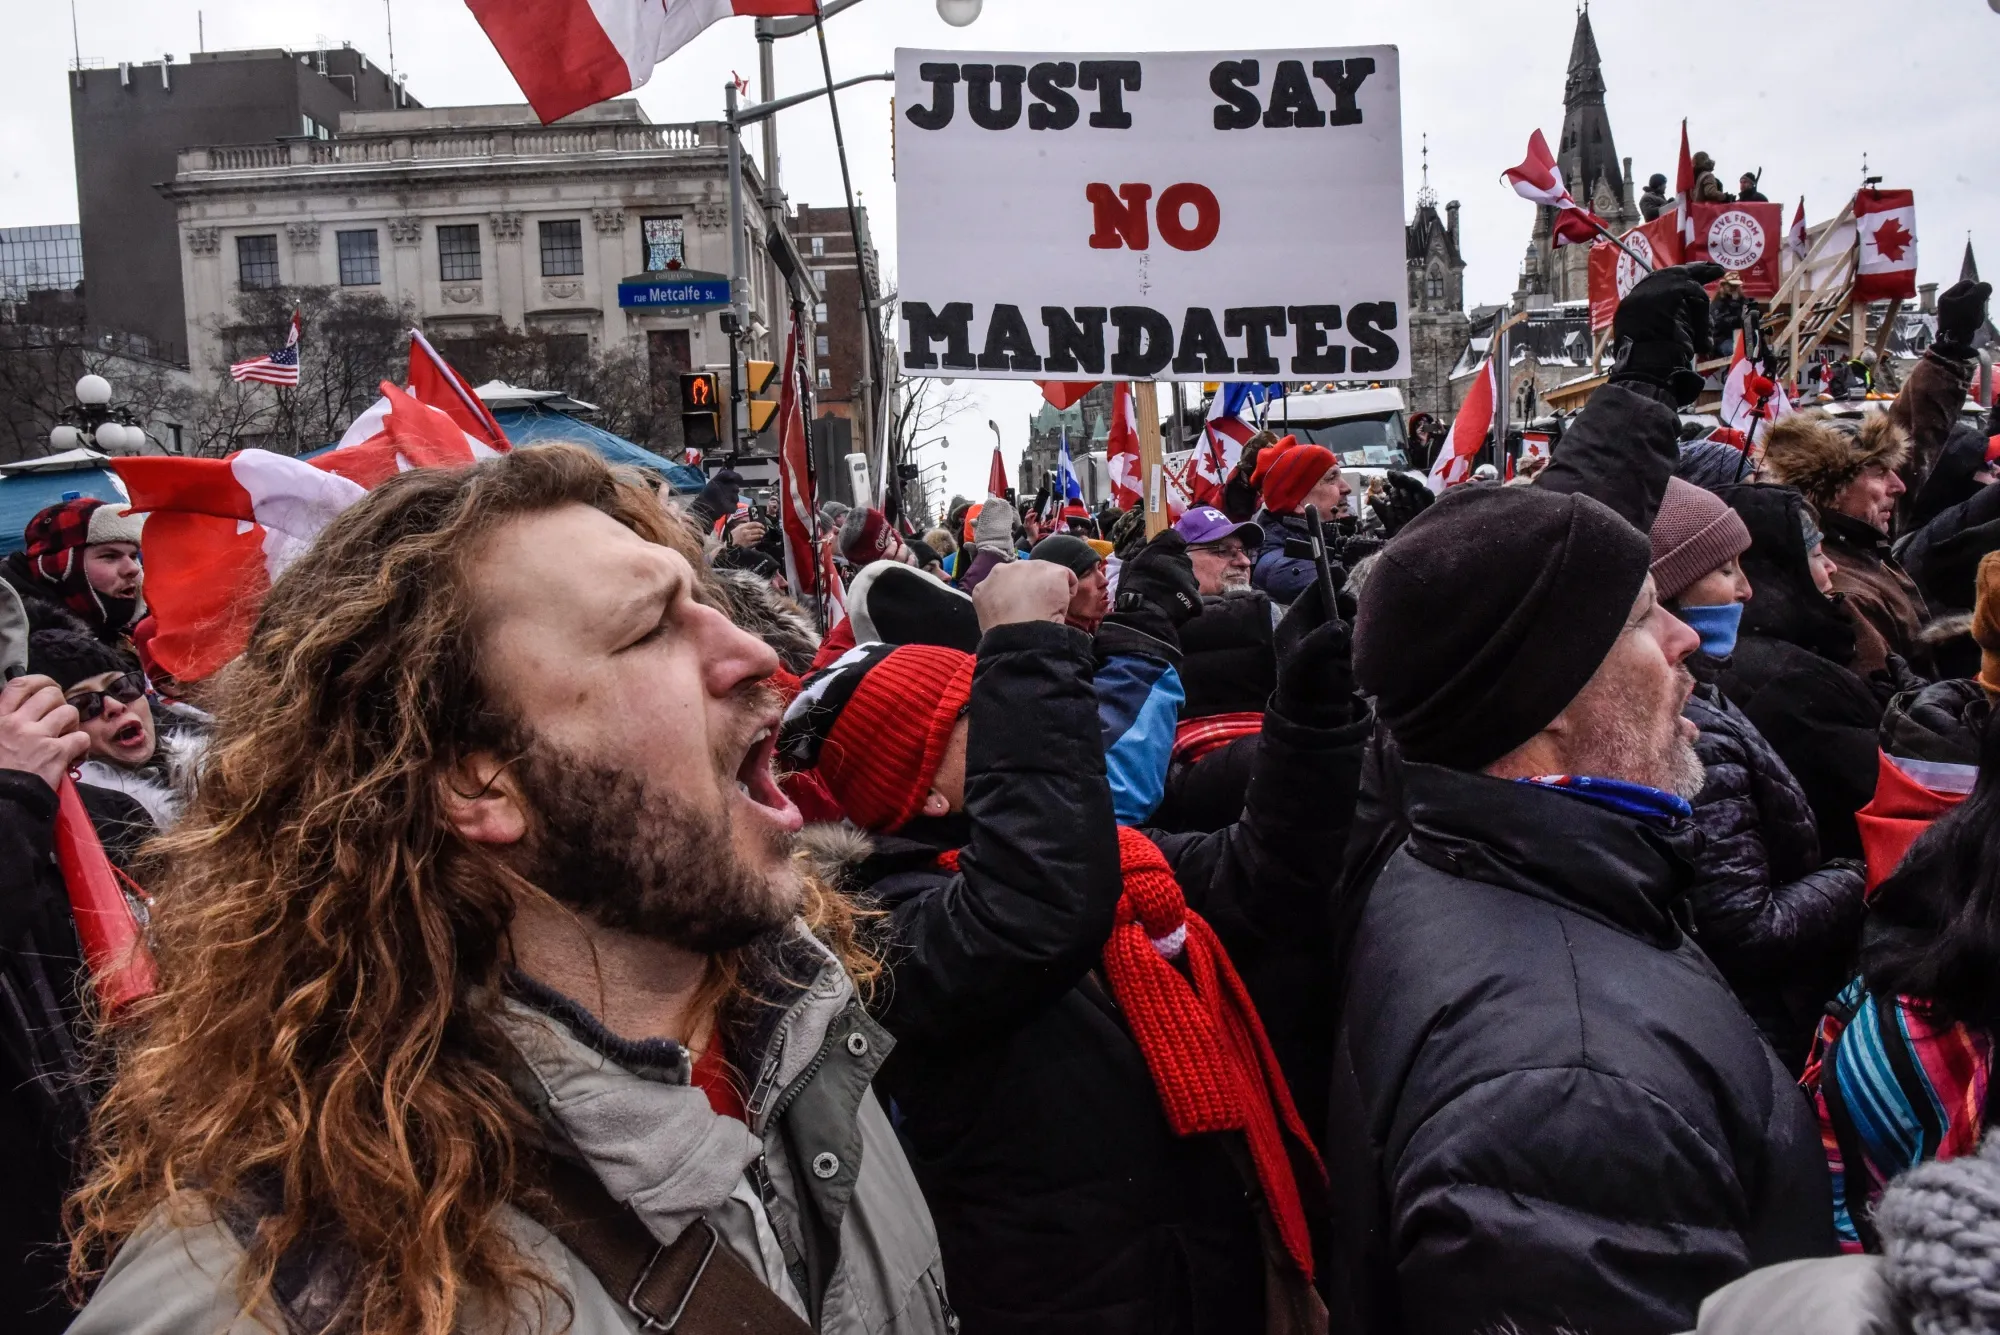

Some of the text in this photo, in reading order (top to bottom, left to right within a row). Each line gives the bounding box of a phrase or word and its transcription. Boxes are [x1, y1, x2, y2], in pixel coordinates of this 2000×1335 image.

[905, 57, 1376, 131] JUST SAY
[1086, 182, 1220, 252] NO
[1712, 214, 1759, 236] LIVE FROM
[1716, 252, 1757, 267] THE SHED
[633, 285, 716, 303] rue Metcalfe St.
[902, 301, 1400, 375] MANDATES
[1176, 591, 1193, 609] HEAD
